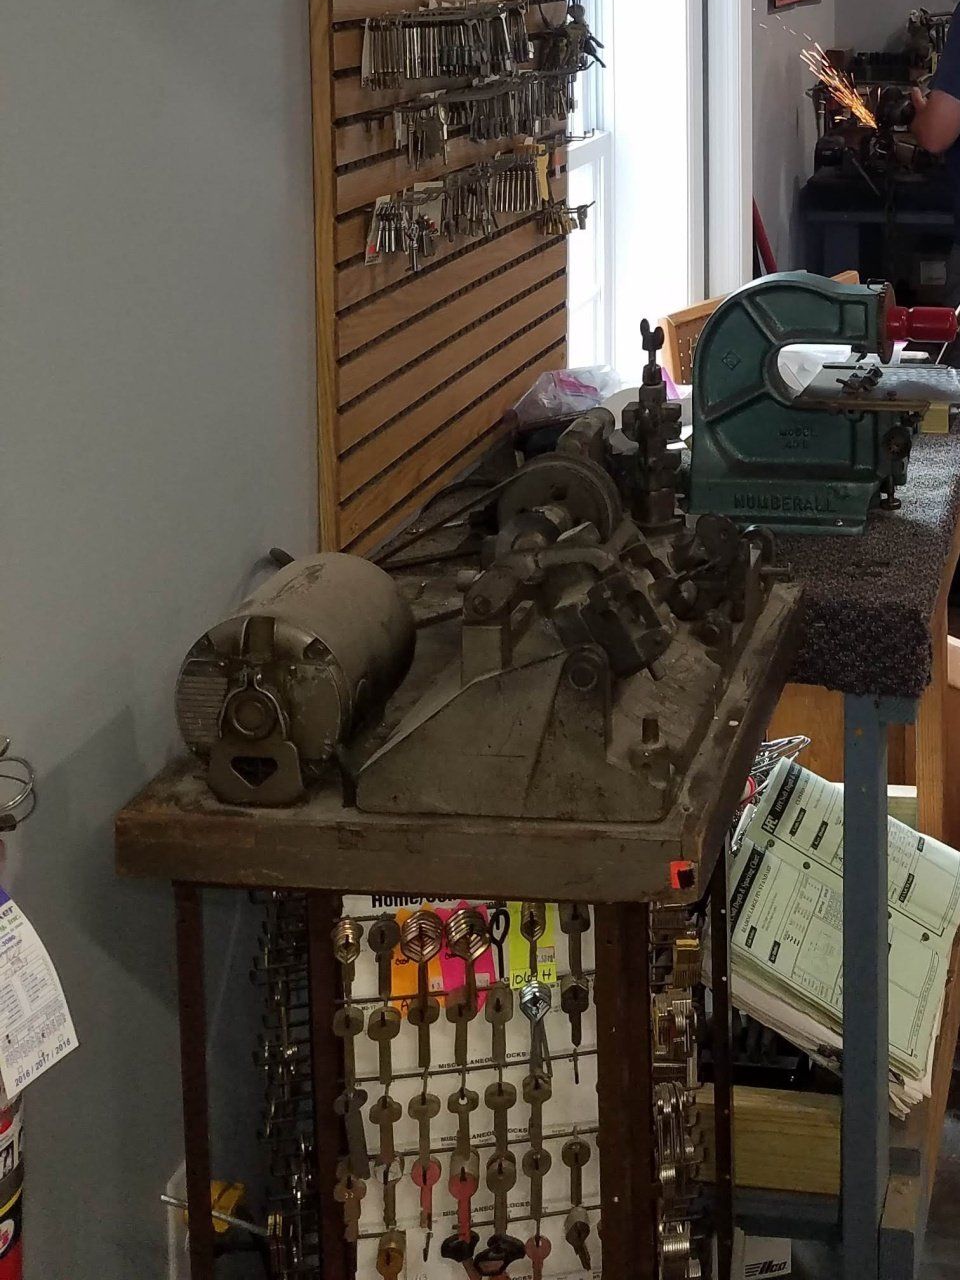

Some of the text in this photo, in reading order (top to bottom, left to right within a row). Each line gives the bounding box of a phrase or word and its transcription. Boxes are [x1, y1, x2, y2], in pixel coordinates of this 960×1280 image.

[733, 494, 836, 513] NUMBERALL
[732, 892, 744, 909] Depth
[742, 866, 755, 889] Spacing
[748, 898, 757, 914] LARGE
[542, 968, 552, 981] H
[35, 1053, 50, 1071] 2017
